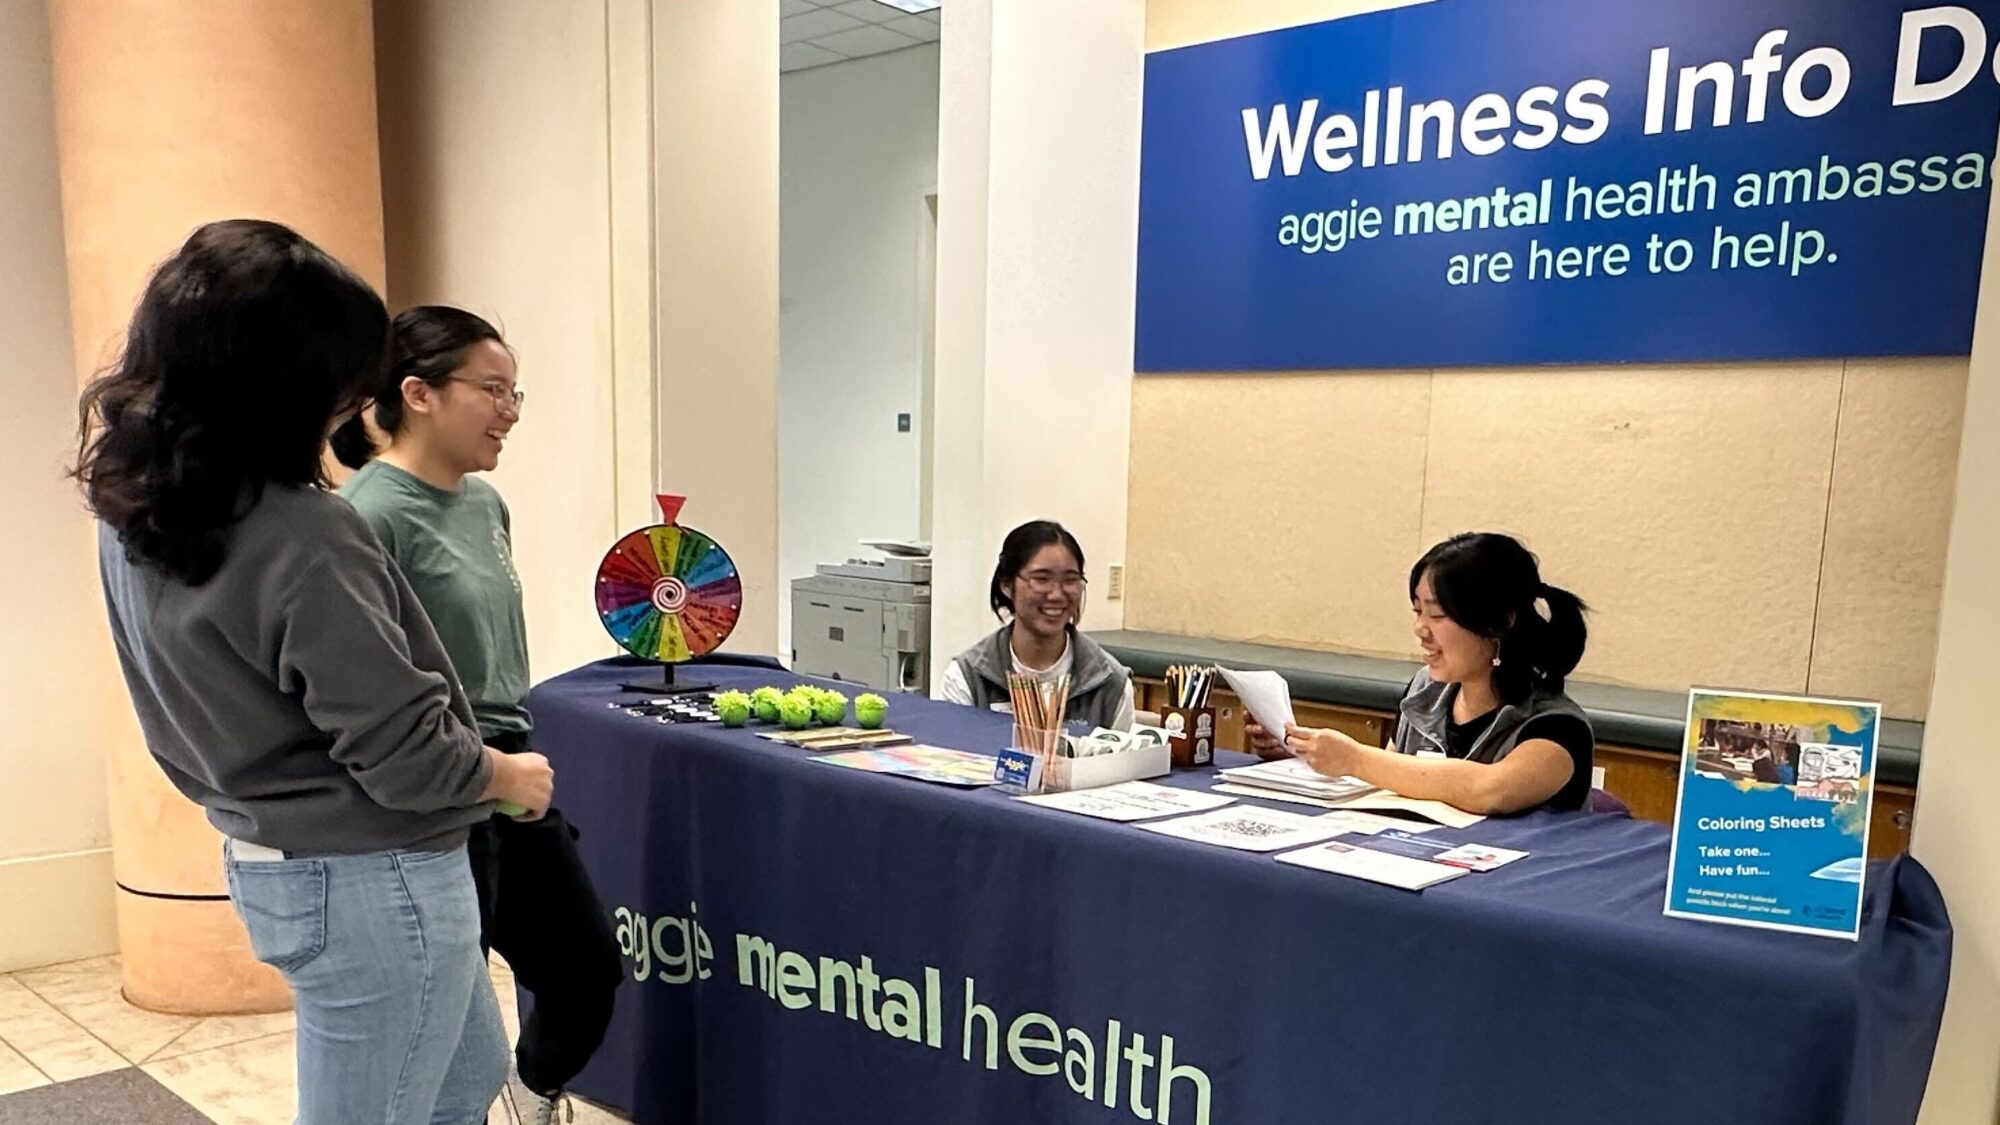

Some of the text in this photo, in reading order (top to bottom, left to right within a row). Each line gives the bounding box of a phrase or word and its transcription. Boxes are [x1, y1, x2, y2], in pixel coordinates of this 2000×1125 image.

[1241, 6, 2000, 180] Wellness Info D
[1278, 152, 1988, 254] aggie mental health ambassa
[1446, 220, 1838, 286] are here to help.
[1697, 815, 1826, 832] Coloring Sheets
[1698, 845, 1771, 857] Take one...
[1699, 864, 1771, 876] Have fun...
[614, 900, 1212, 1125] aggie mental health
